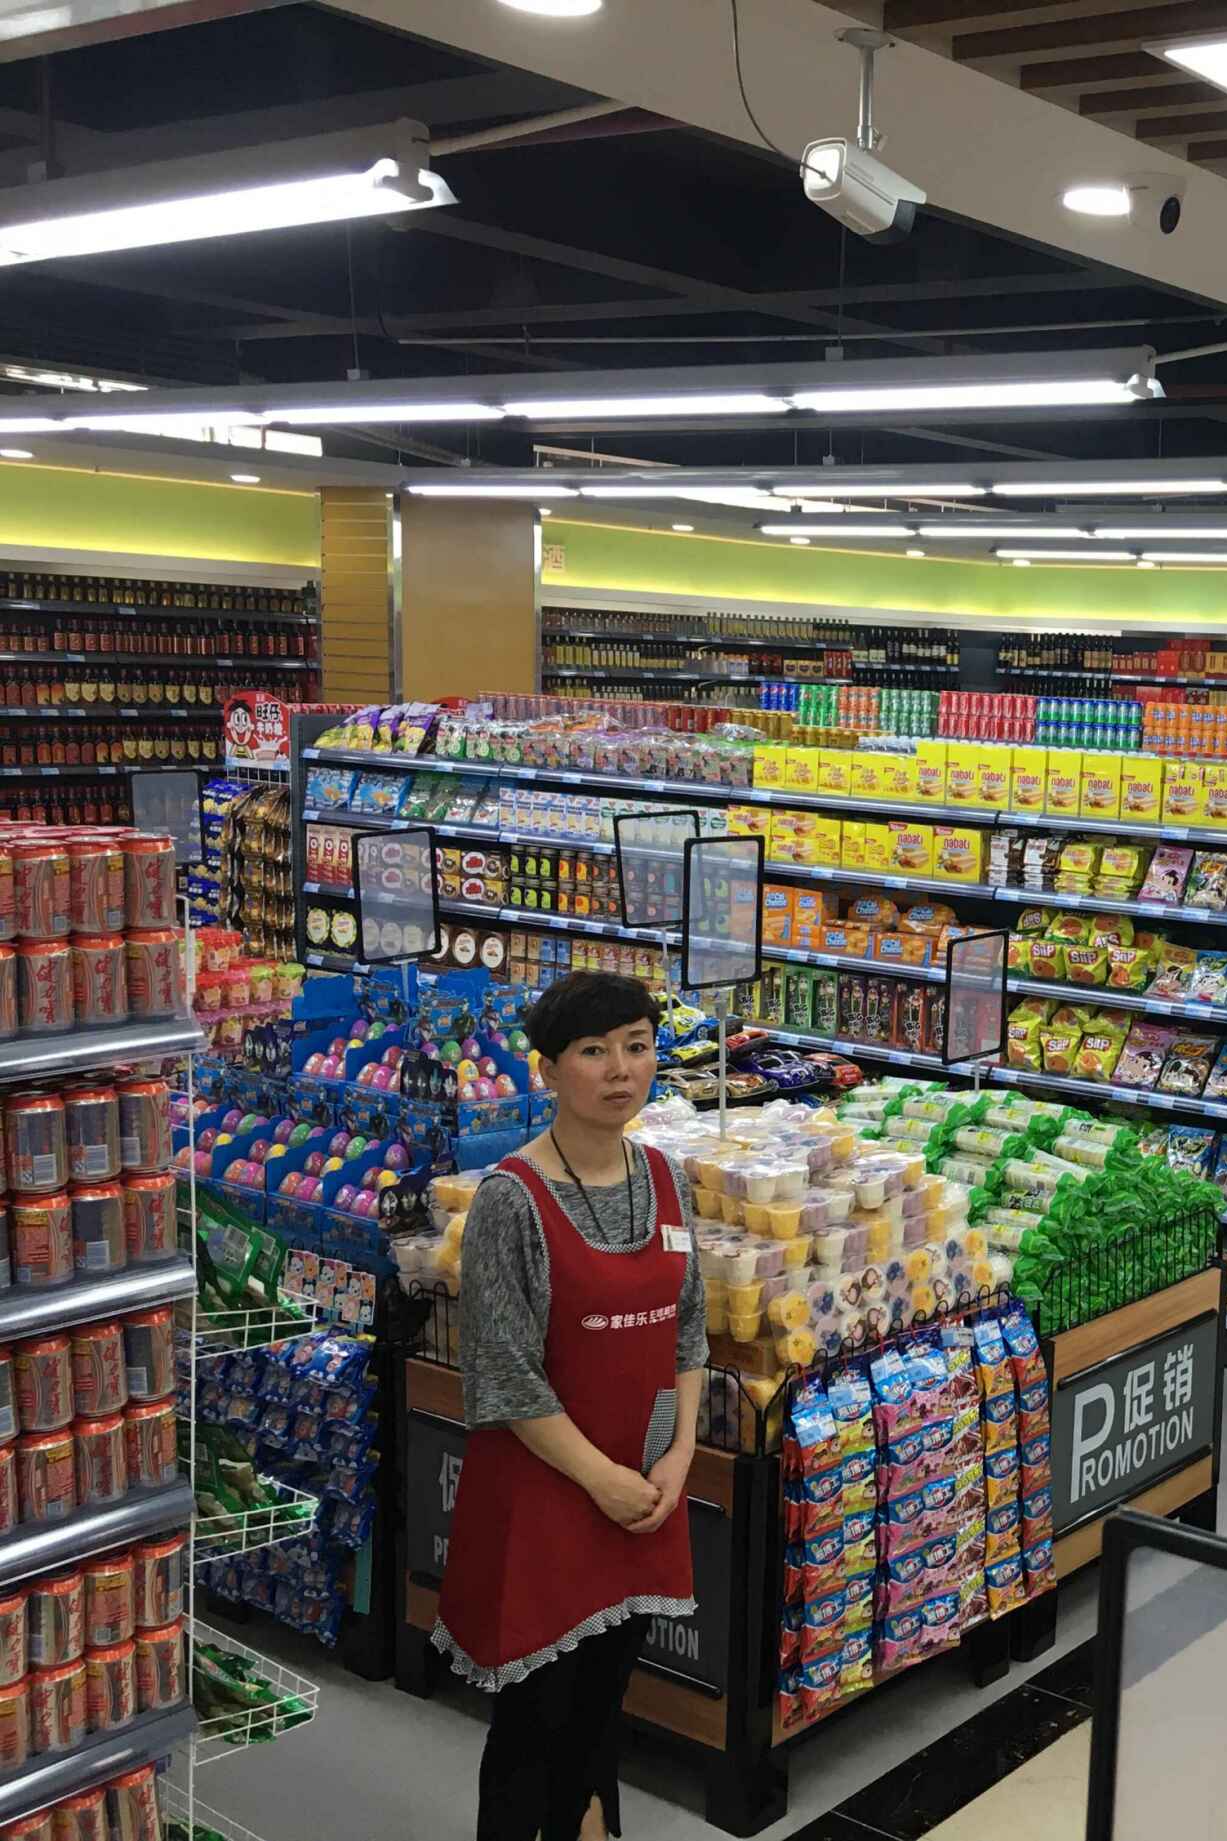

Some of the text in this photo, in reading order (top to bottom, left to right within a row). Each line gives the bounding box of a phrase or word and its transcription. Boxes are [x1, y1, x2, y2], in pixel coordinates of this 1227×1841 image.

[256, 704, 280, 720] 旺仔
[919, 767, 941, 777] nabati
[950, 770, 974, 781] nabati
[982, 771, 1006, 782] nabati
[1017, 775, 1040, 785] nabati
[1051, 776, 1075, 787] nabati
[1088, 779, 1112, 790] nabati
[1128, 782, 1153, 793] nabati
[1169, 785, 1194, 797] nabati
[897, 833, 923, 845] nabati
[943, 838, 970, 850] nabati
[36, 957, 56, 1024] 健力宝
[611, 1312, 648, 1329] 家佳乐
[1123, 1344, 1194, 1434] 促销
